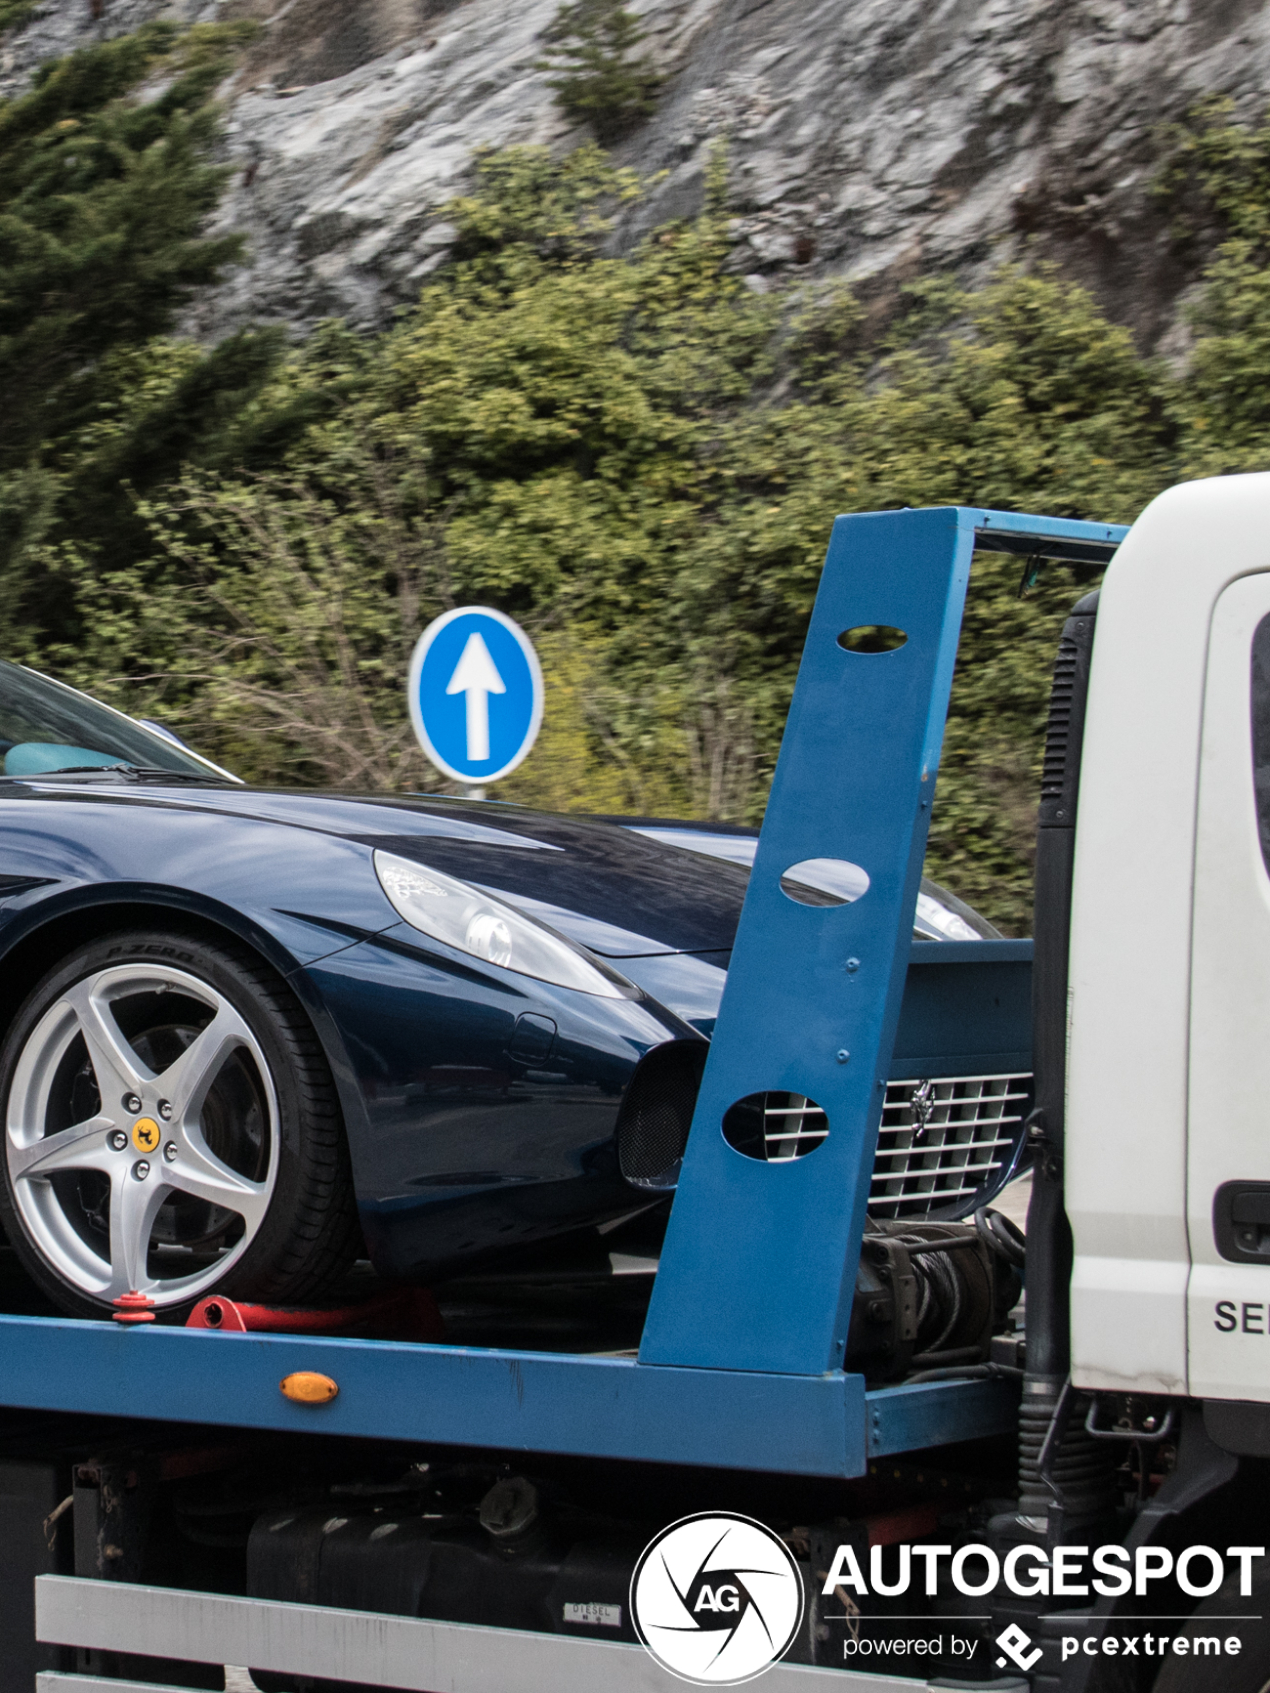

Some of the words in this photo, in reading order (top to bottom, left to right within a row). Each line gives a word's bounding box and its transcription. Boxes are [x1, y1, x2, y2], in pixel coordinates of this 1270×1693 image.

[129, 944, 195, 963] ZERO
[1213, 1299, 1270, 1335] SE
[572, 1604, 611, 1617] DIESEL
